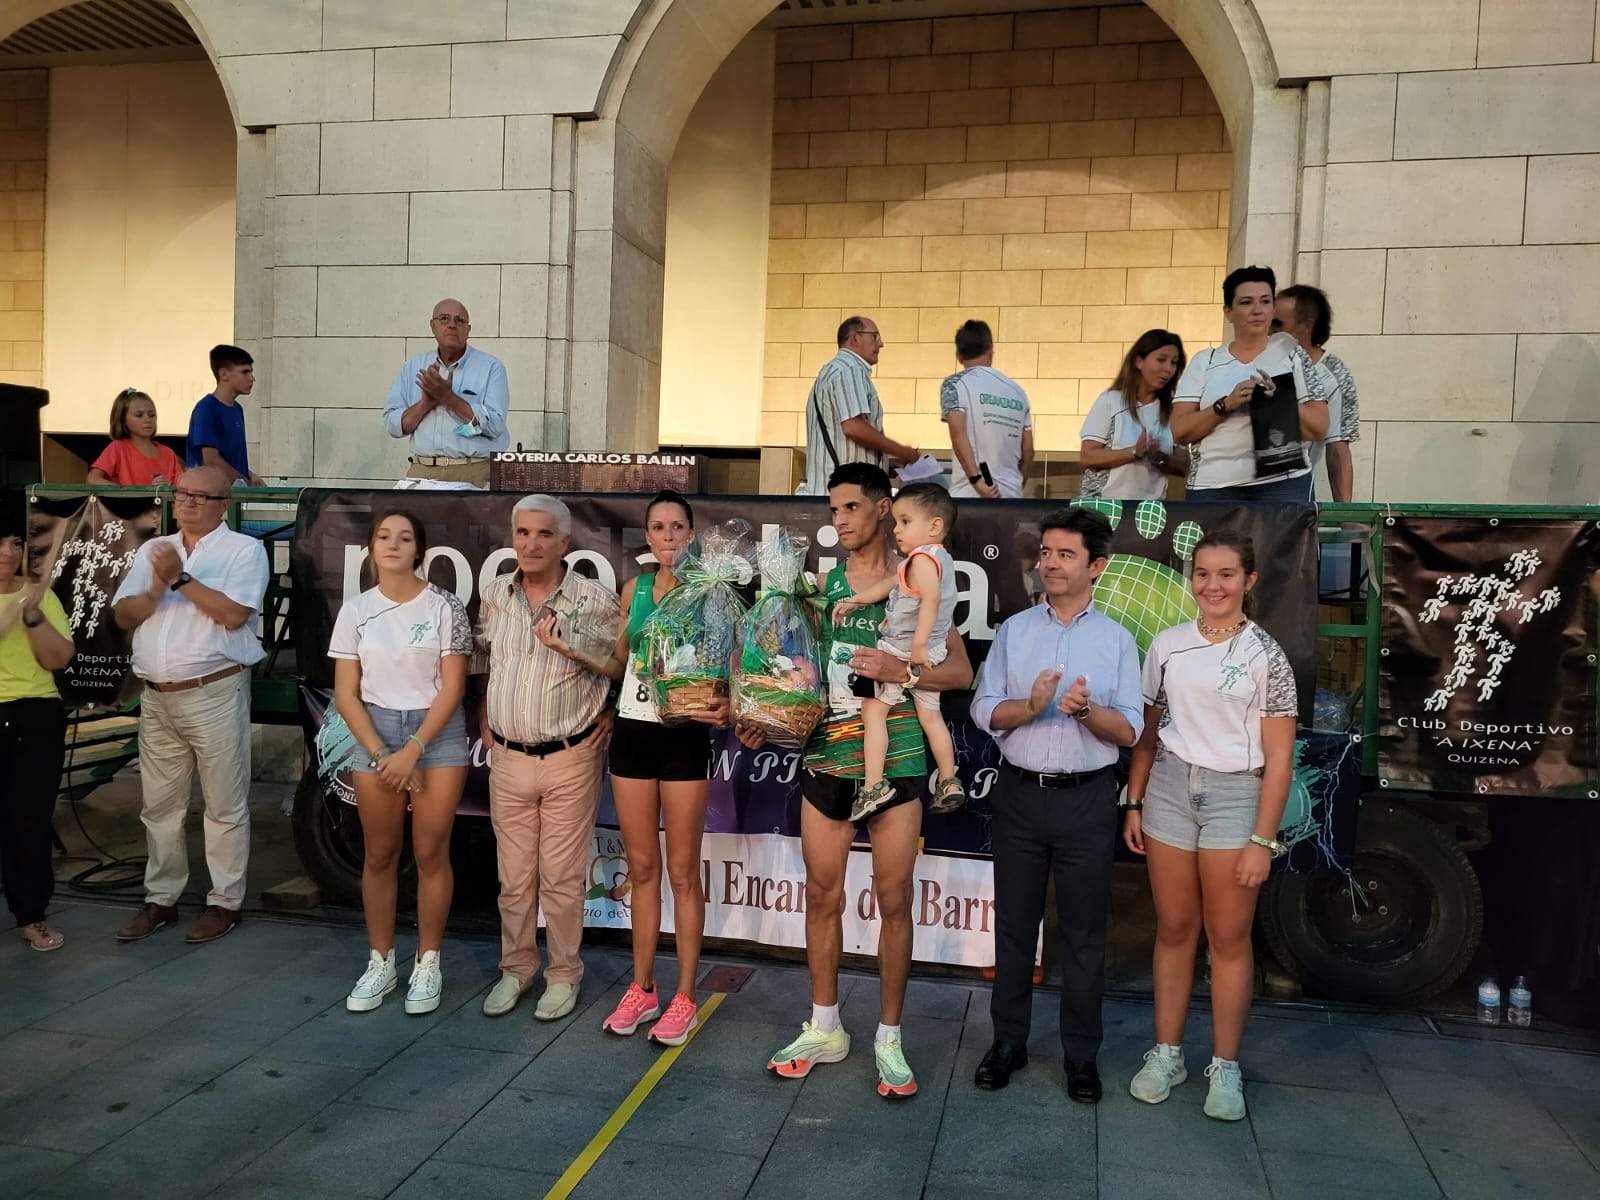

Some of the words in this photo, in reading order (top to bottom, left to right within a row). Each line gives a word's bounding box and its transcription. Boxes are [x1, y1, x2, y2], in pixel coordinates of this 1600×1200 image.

[494, 452, 562, 463] JOYERIA
[565, 453, 632, 464] CARLOS
[636, 454, 696, 466] BAILIN
[1397, 716, 1447, 730] Club
[1460, 720, 1574, 736] Deportivo
[1447, 753, 1520, 766] QUIZENA
